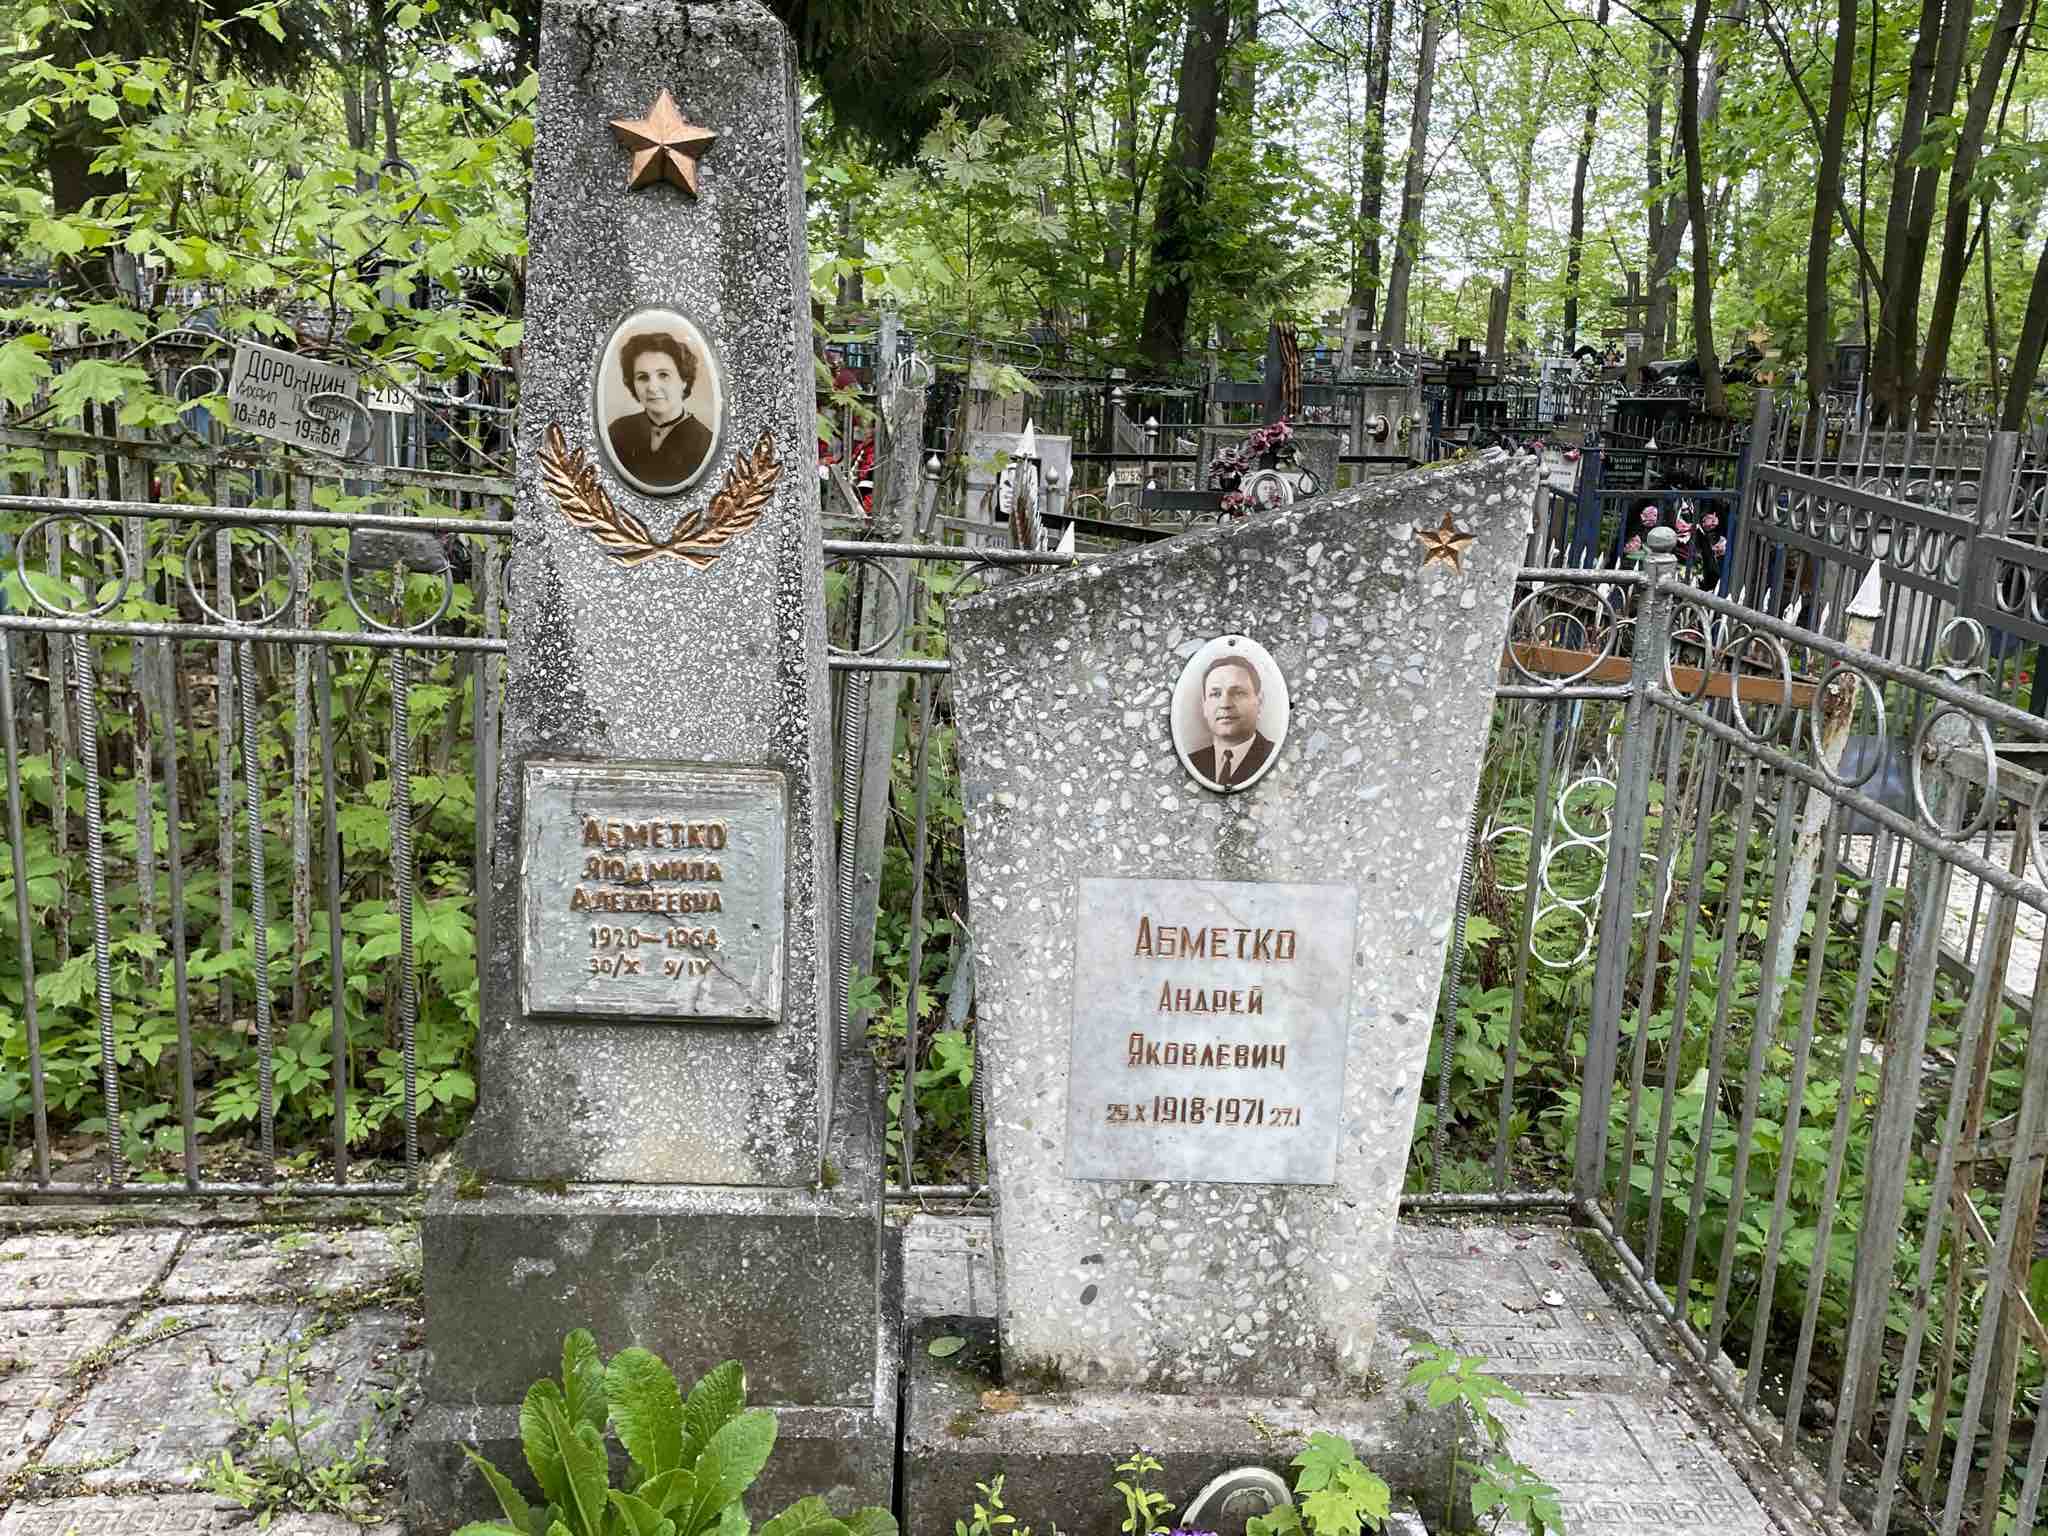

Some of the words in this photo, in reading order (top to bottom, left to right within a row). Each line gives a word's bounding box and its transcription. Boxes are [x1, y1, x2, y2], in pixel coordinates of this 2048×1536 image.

[245, 350, 346, 394] ДОРОЖКИН
[584, 817, 728, 850] АБМЕТКО
[582, 855, 723, 884] ЛЮДМИЛА
[1135, 914, 1297, 961] АБМЕТКО
[1158, 979, 1265, 1015] АНДРЕЙ
[1127, 1031, 1288, 1071] ЯКОВЛЕВИЧ
